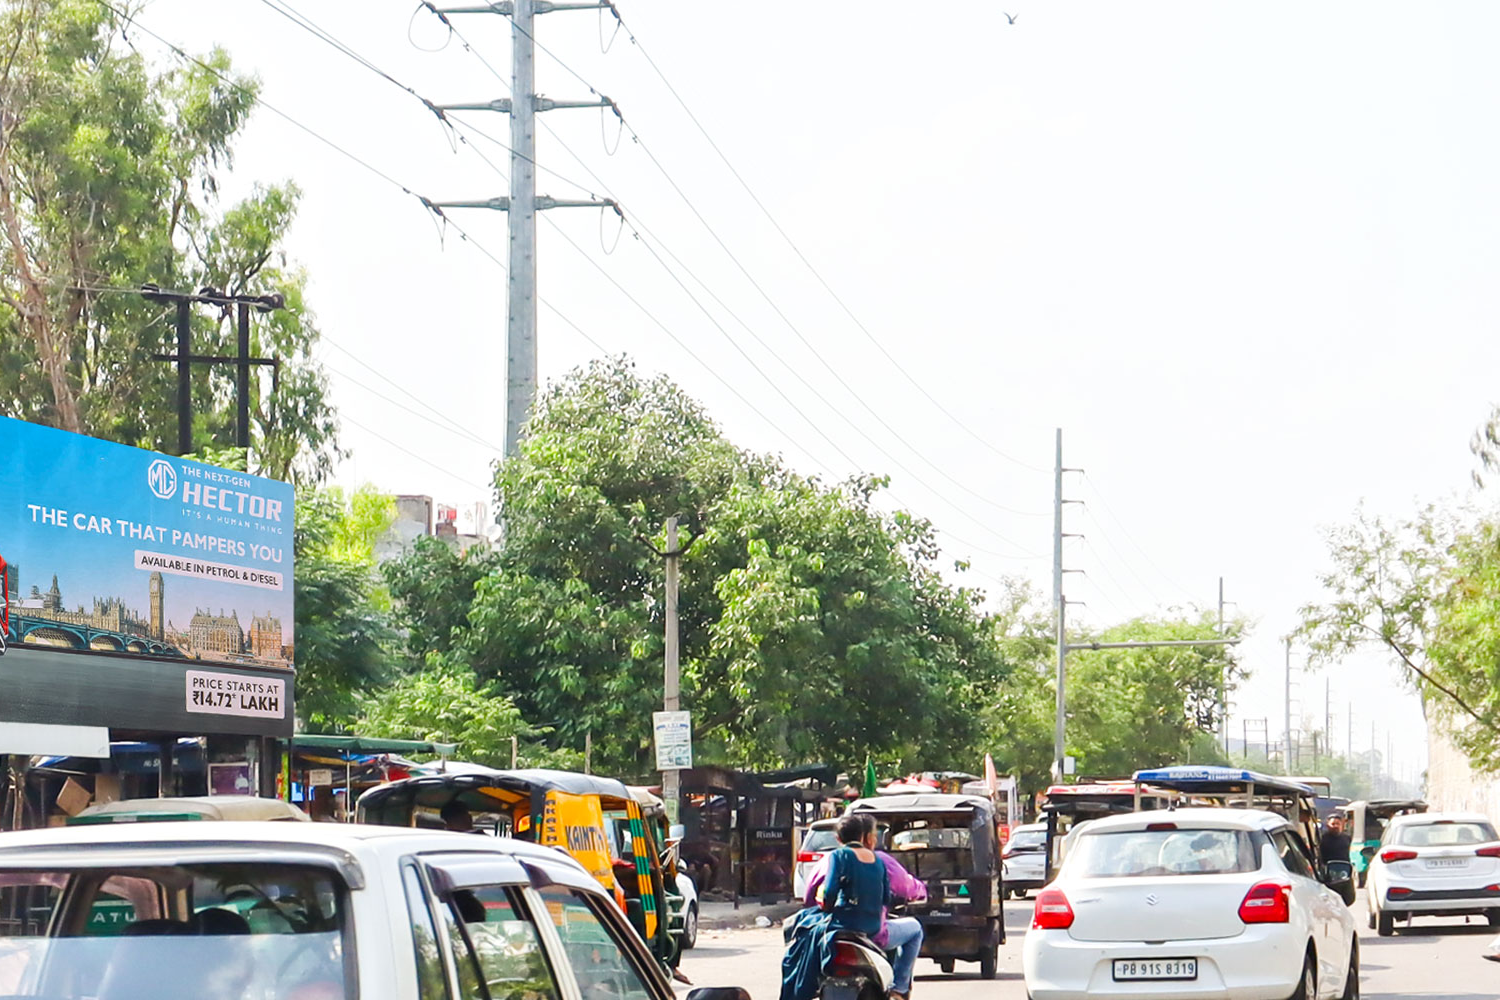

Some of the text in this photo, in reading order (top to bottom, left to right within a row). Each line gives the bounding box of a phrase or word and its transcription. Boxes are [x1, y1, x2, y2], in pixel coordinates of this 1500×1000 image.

[148, 459, 177, 499] MG
[182, 465, 251, 488] THE NEXT-GEN
[182, 481, 282, 521] HECTOR
[27, 504, 283, 563] THE CAR THAT PAMPERS YOU
[182, 508, 201, 519] IT'S
[217, 517, 250, 528] HUMAN
[255, 523, 283, 534] THING
[141, 556, 278, 586] AVAILABLE IN PETROL & DIESEL
[193, 677, 279, 694] PRICE STARTS AT
[240, 695, 278, 712] LAKH
[544, 799, 558, 847] AKASH
[756, 831, 783, 839] Rinku
[1122, 963, 1136, 975] PB
[1166, 962, 1194, 975] 8319
